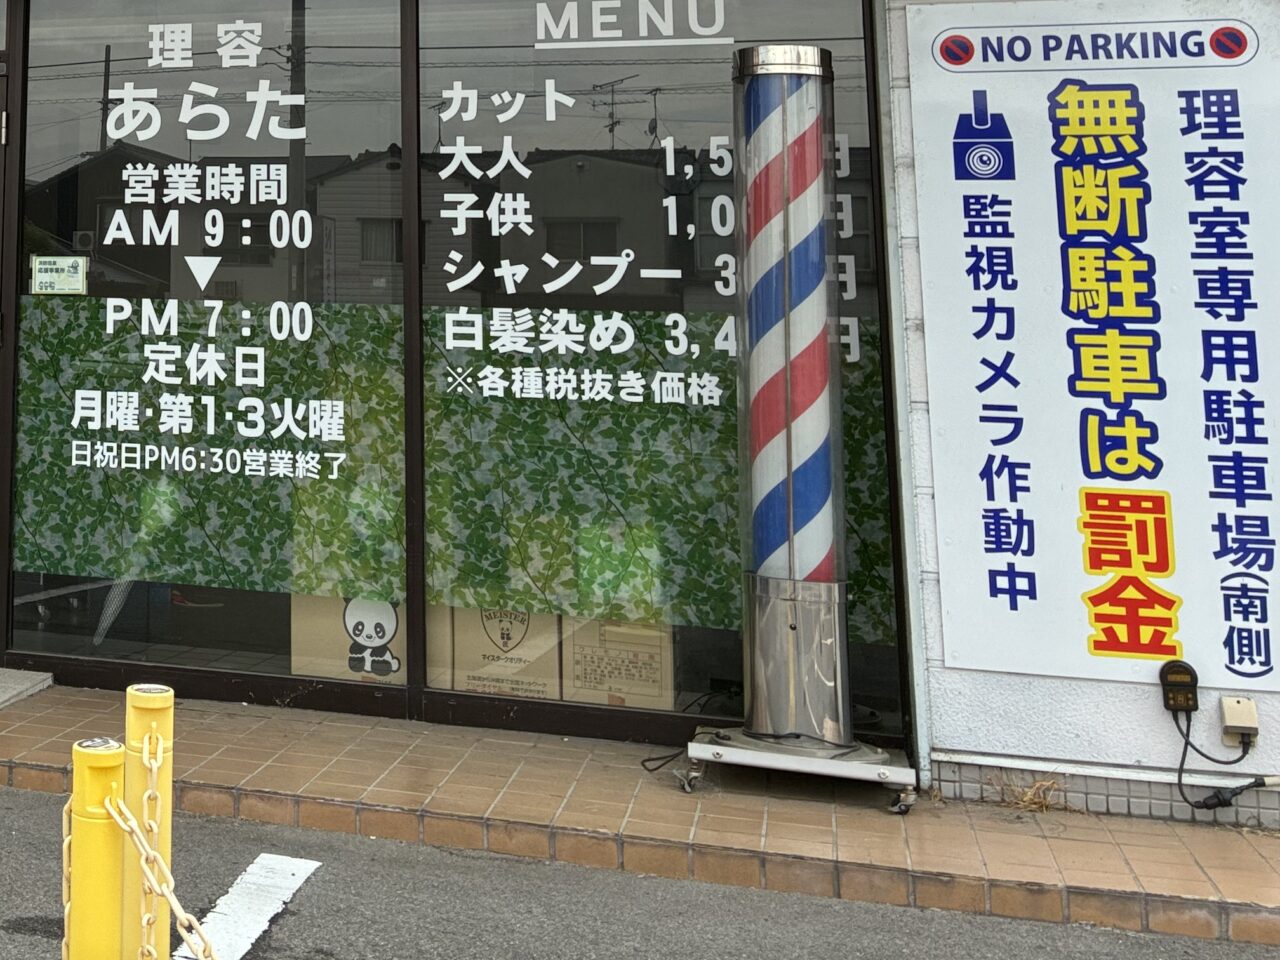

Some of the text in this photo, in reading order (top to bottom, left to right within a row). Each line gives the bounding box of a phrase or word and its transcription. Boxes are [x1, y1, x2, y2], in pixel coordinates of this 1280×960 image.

[980, 30, 1205, 63] NO PARKING
[106, 79, 307, 141] あらた
[439, 79, 576, 123] カット
[439, 136, 533, 180] 大人
[122, 163, 288, 205] 営業時間
[103, 209, 180, 247] AM
[440, 193, 534, 237] 子供
[442, 248, 682, 296] シャンプー
[106, 297, 179, 336] PM
[444, 307, 635, 355] 白髪染め
[142, 342, 265, 387] 定休日
[961, 193, 1039, 612] 監視カメラ作動中
